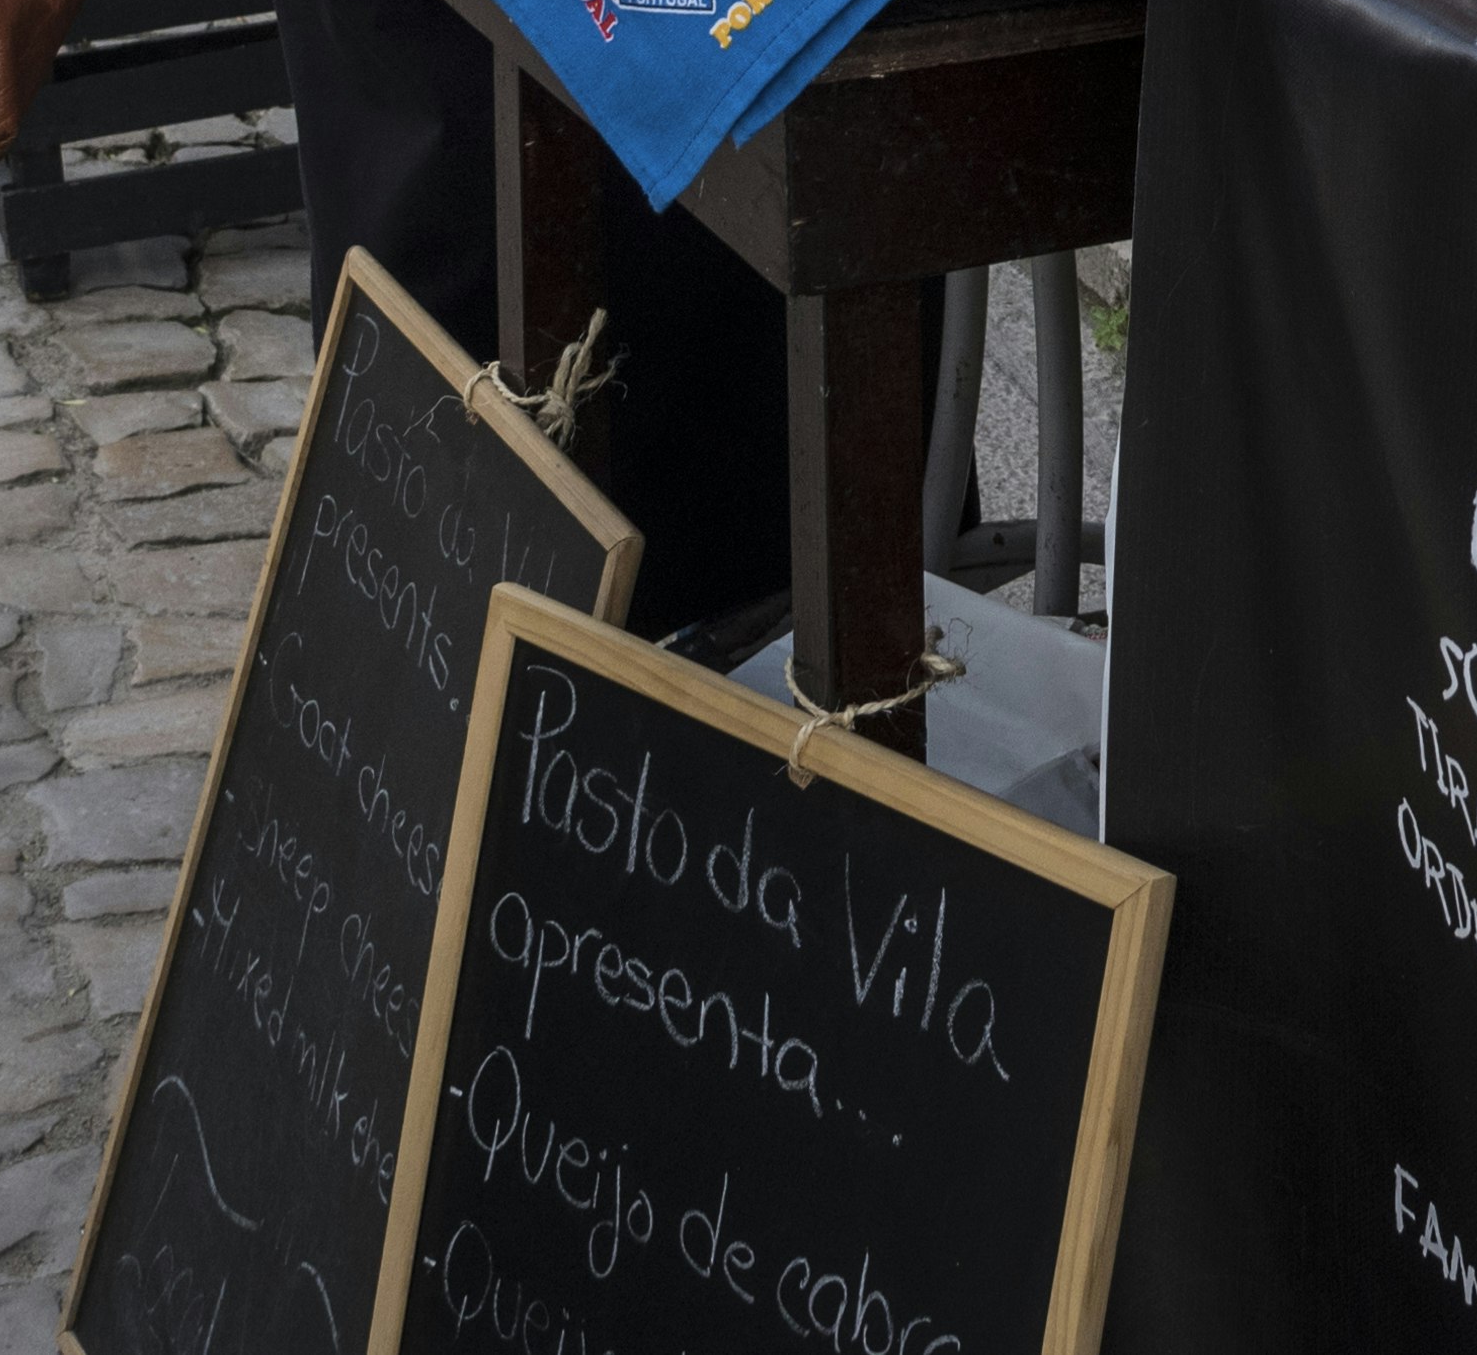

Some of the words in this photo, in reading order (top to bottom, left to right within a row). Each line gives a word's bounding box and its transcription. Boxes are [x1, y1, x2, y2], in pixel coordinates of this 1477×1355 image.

[335, 313, 427, 518] Pasto
[520, 665, 688, 884] Pasto
[707, 807, 803, 949] da
[845, 852, 1009, 1082] Vila
[679, 1172, 756, 1304] de
